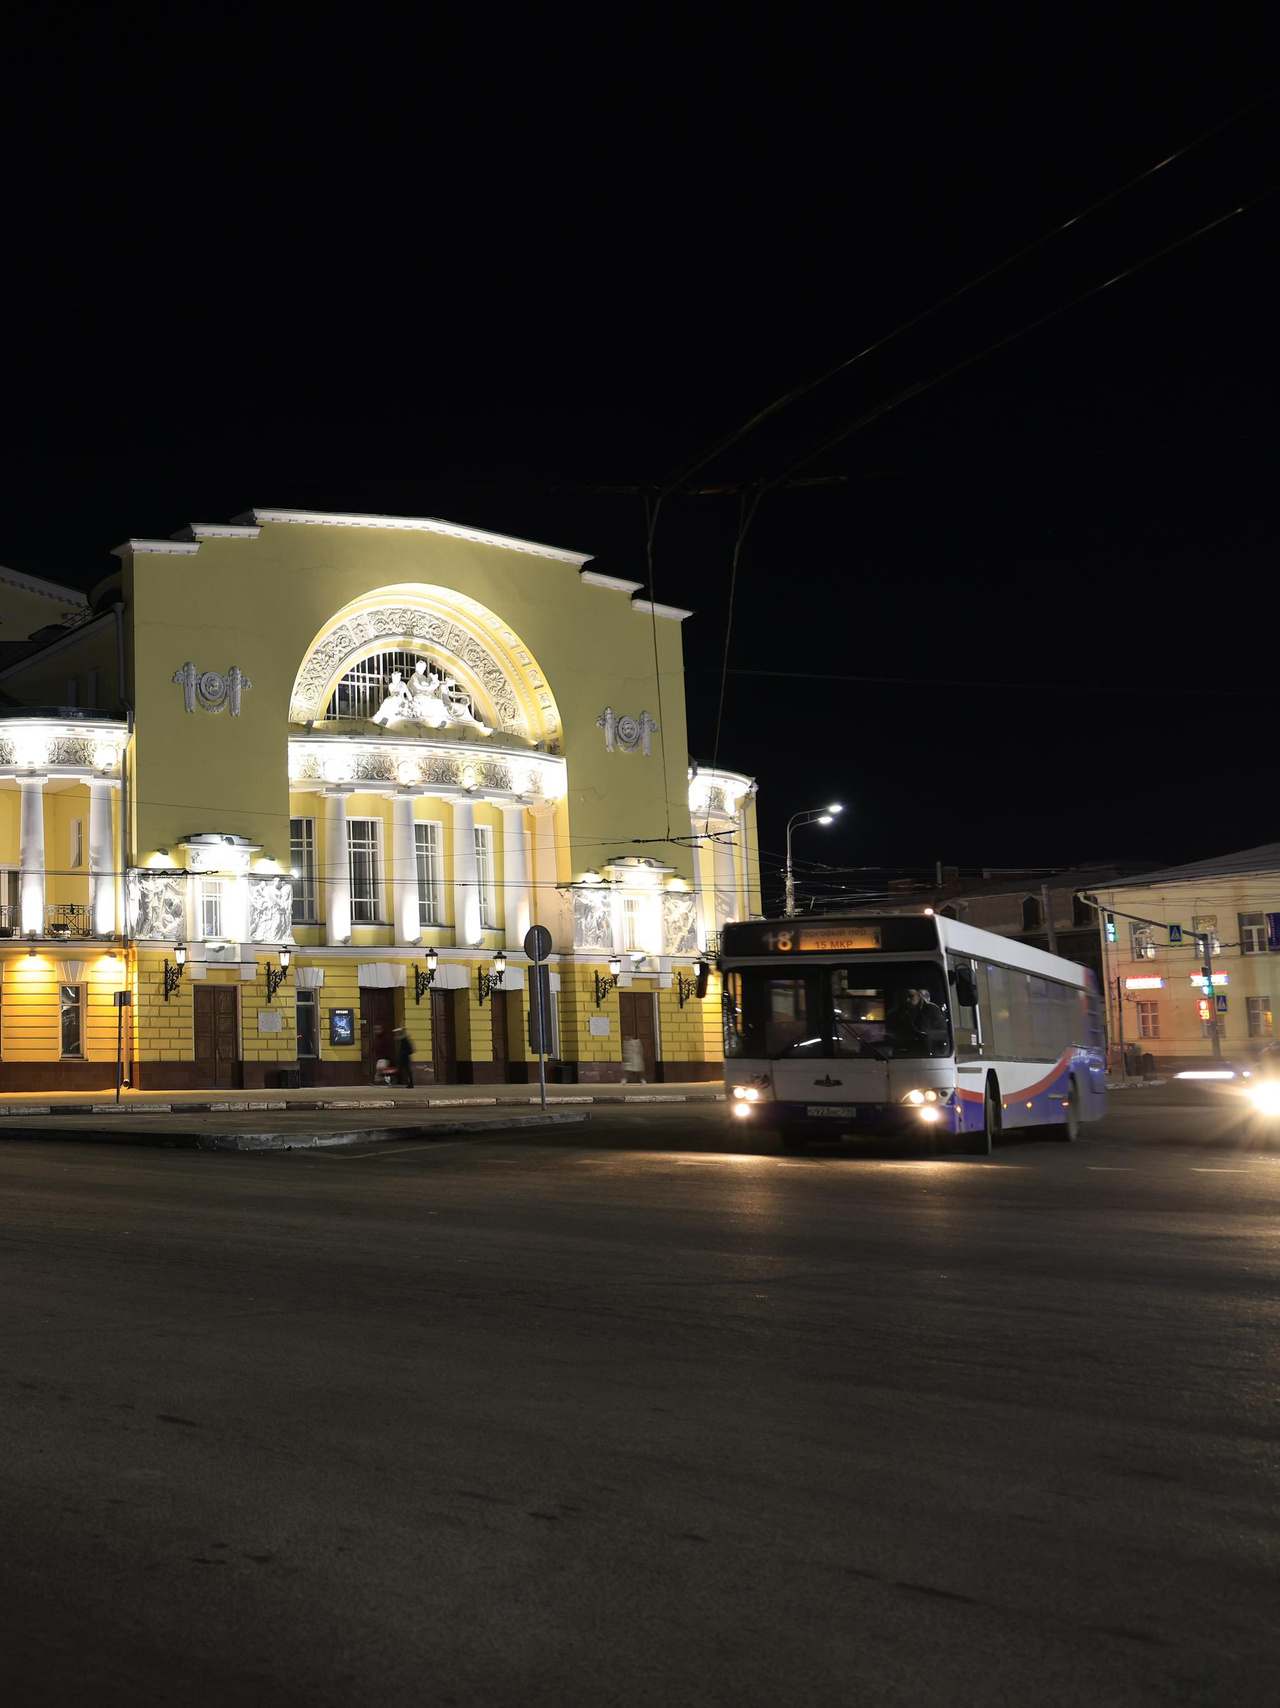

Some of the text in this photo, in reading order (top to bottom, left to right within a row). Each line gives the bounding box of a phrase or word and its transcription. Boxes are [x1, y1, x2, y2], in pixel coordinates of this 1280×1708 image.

[763, 930, 793, 951] 18
[815, 940, 854, 949] 15 МКР
